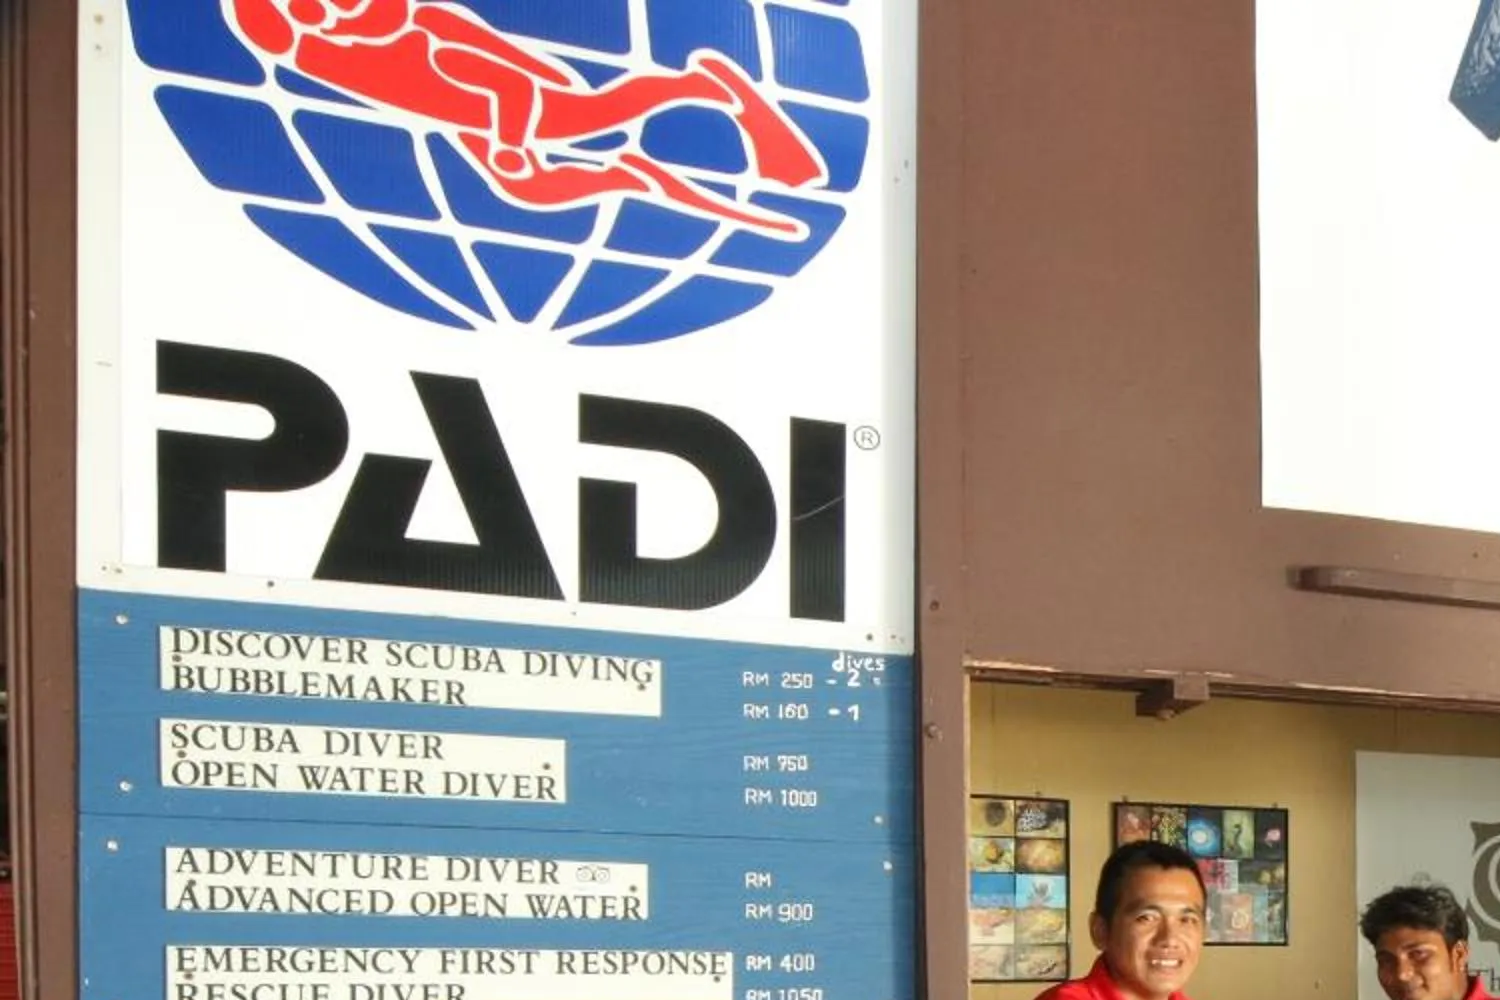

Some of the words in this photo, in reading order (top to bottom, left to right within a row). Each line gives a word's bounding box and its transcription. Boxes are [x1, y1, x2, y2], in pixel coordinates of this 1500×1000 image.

[157, 339, 846, 622] PADI
[171, 628, 368, 664] DISCOVER
[386, 641, 506, 674] SCUBA
[523, 651, 653, 683] DIVING
[832, 652, 885, 672] dives
[172, 665, 466, 705] BUBBLEMAKER
[743, 671, 769, 687] RM
[781, 672, 813, 689] 250
[847, 669, 860, 687] 2
[743, 703, 769, 719] RM
[778, 703, 809, 720] 160
[171, 723, 301, 754] SCUBA
[324, 729, 444, 760] DIVER
[743, 755, 769, 771] RM
[777, 755, 808, 772] 750
[171, 758, 279, 789] OPEN
[297, 765, 425, 795] WATER
[442, 771, 557, 800] DIVER
[745, 788, 772, 805] RM
[781, 789, 817, 807] 1000
[175, 848, 429, 880] ADVENTURE
[445, 857, 560, 884] DIVER
[745, 871, 771, 889] RM
[175, 884, 394, 915] ADVANCED
[410, 892, 509, 917] OPEN
[526, 893, 643, 919] WATER
[745, 903, 772, 919] RM
[778, 903, 813, 922] 900
[175, 948, 420, 974] EMERGENCY
[439, 950, 541, 975] FIRST
[556, 951, 727, 976] RESPONSE
[745, 955, 771, 971] RM
[780, 953, 815, 973] 400
